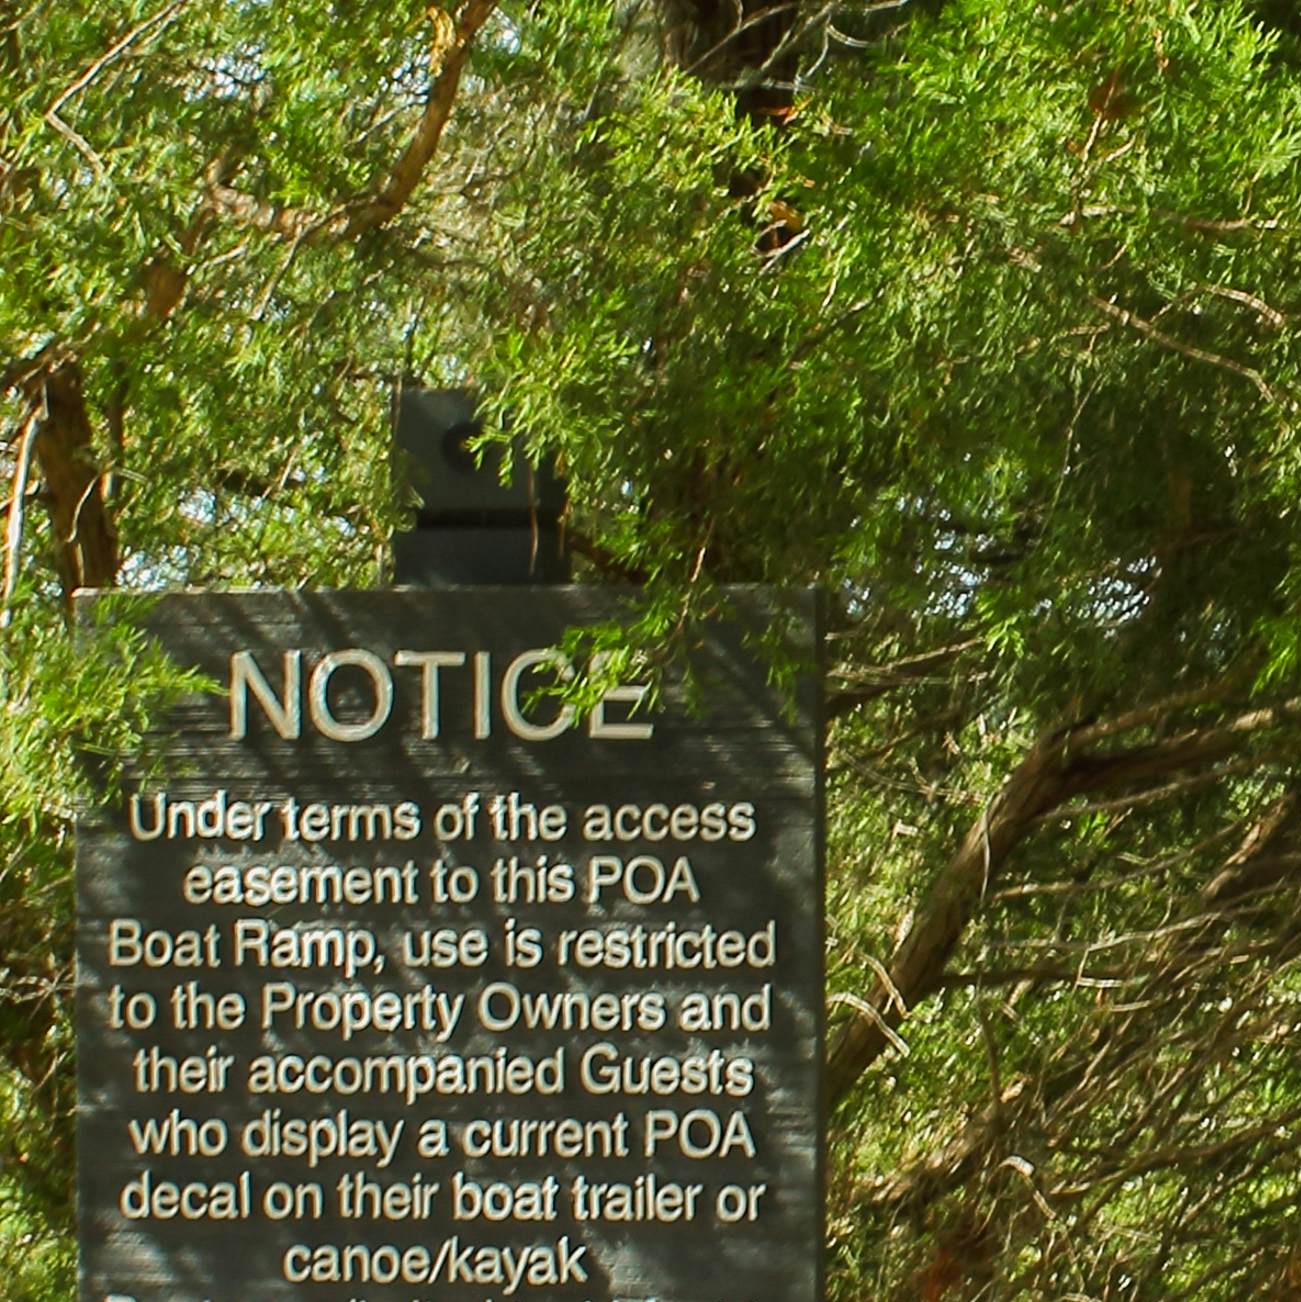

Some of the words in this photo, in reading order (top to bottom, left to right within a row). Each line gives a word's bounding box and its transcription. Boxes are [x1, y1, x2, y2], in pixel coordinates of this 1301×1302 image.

[130, 792, 269, 842] Under
[282, 800, 420, 842] terms
[434, 792, 482, 842] of
[488, 794, 573, 842] the
[583, 802, 756, 842] access
[184, 861, 418, 904] easement
[431, 861, 476, 904] to
[490, 858, 575, 904] this
[589, 857, 700, 903] POA
[109, 920, 219, 967] Boat
[233, 920, 386, 978] Ramp,
[403, 926, 487, 967] use
[505, 920, 543, 967] is
[558, 920, 775, 969] restricted
[109, 988, 155, 1030] to
[171, 983, 245, 1030] the
[262, 984, 462, 1043] Property
[478, 983, 665, 1031] Owners
[681, 985, 770, 1031] and
[134, 1047, 233, 1093] their
[249, 1047, 565, 1105] accompanied
[580, 1045, 754, 1096] Guests
[130, 1111, 227, 1157] who
[242, 1111, 403, 1168] display
[417, 1118, 449, 1158] a
[463, 1112, 628, 1158] current
[644, 1111, 755, 1158] POA
[121, 1172, 250, 1220] decal
[264, 1181, 322, 1220] on
[337, 1173, 438, 1220] their
[453, 1173, 558, 1222] boat
[572, 1176, 702, 1222] trailer
[716, 1182, 765, 1222] or
[283, 1238, 588, 1294] canoe/kayak
